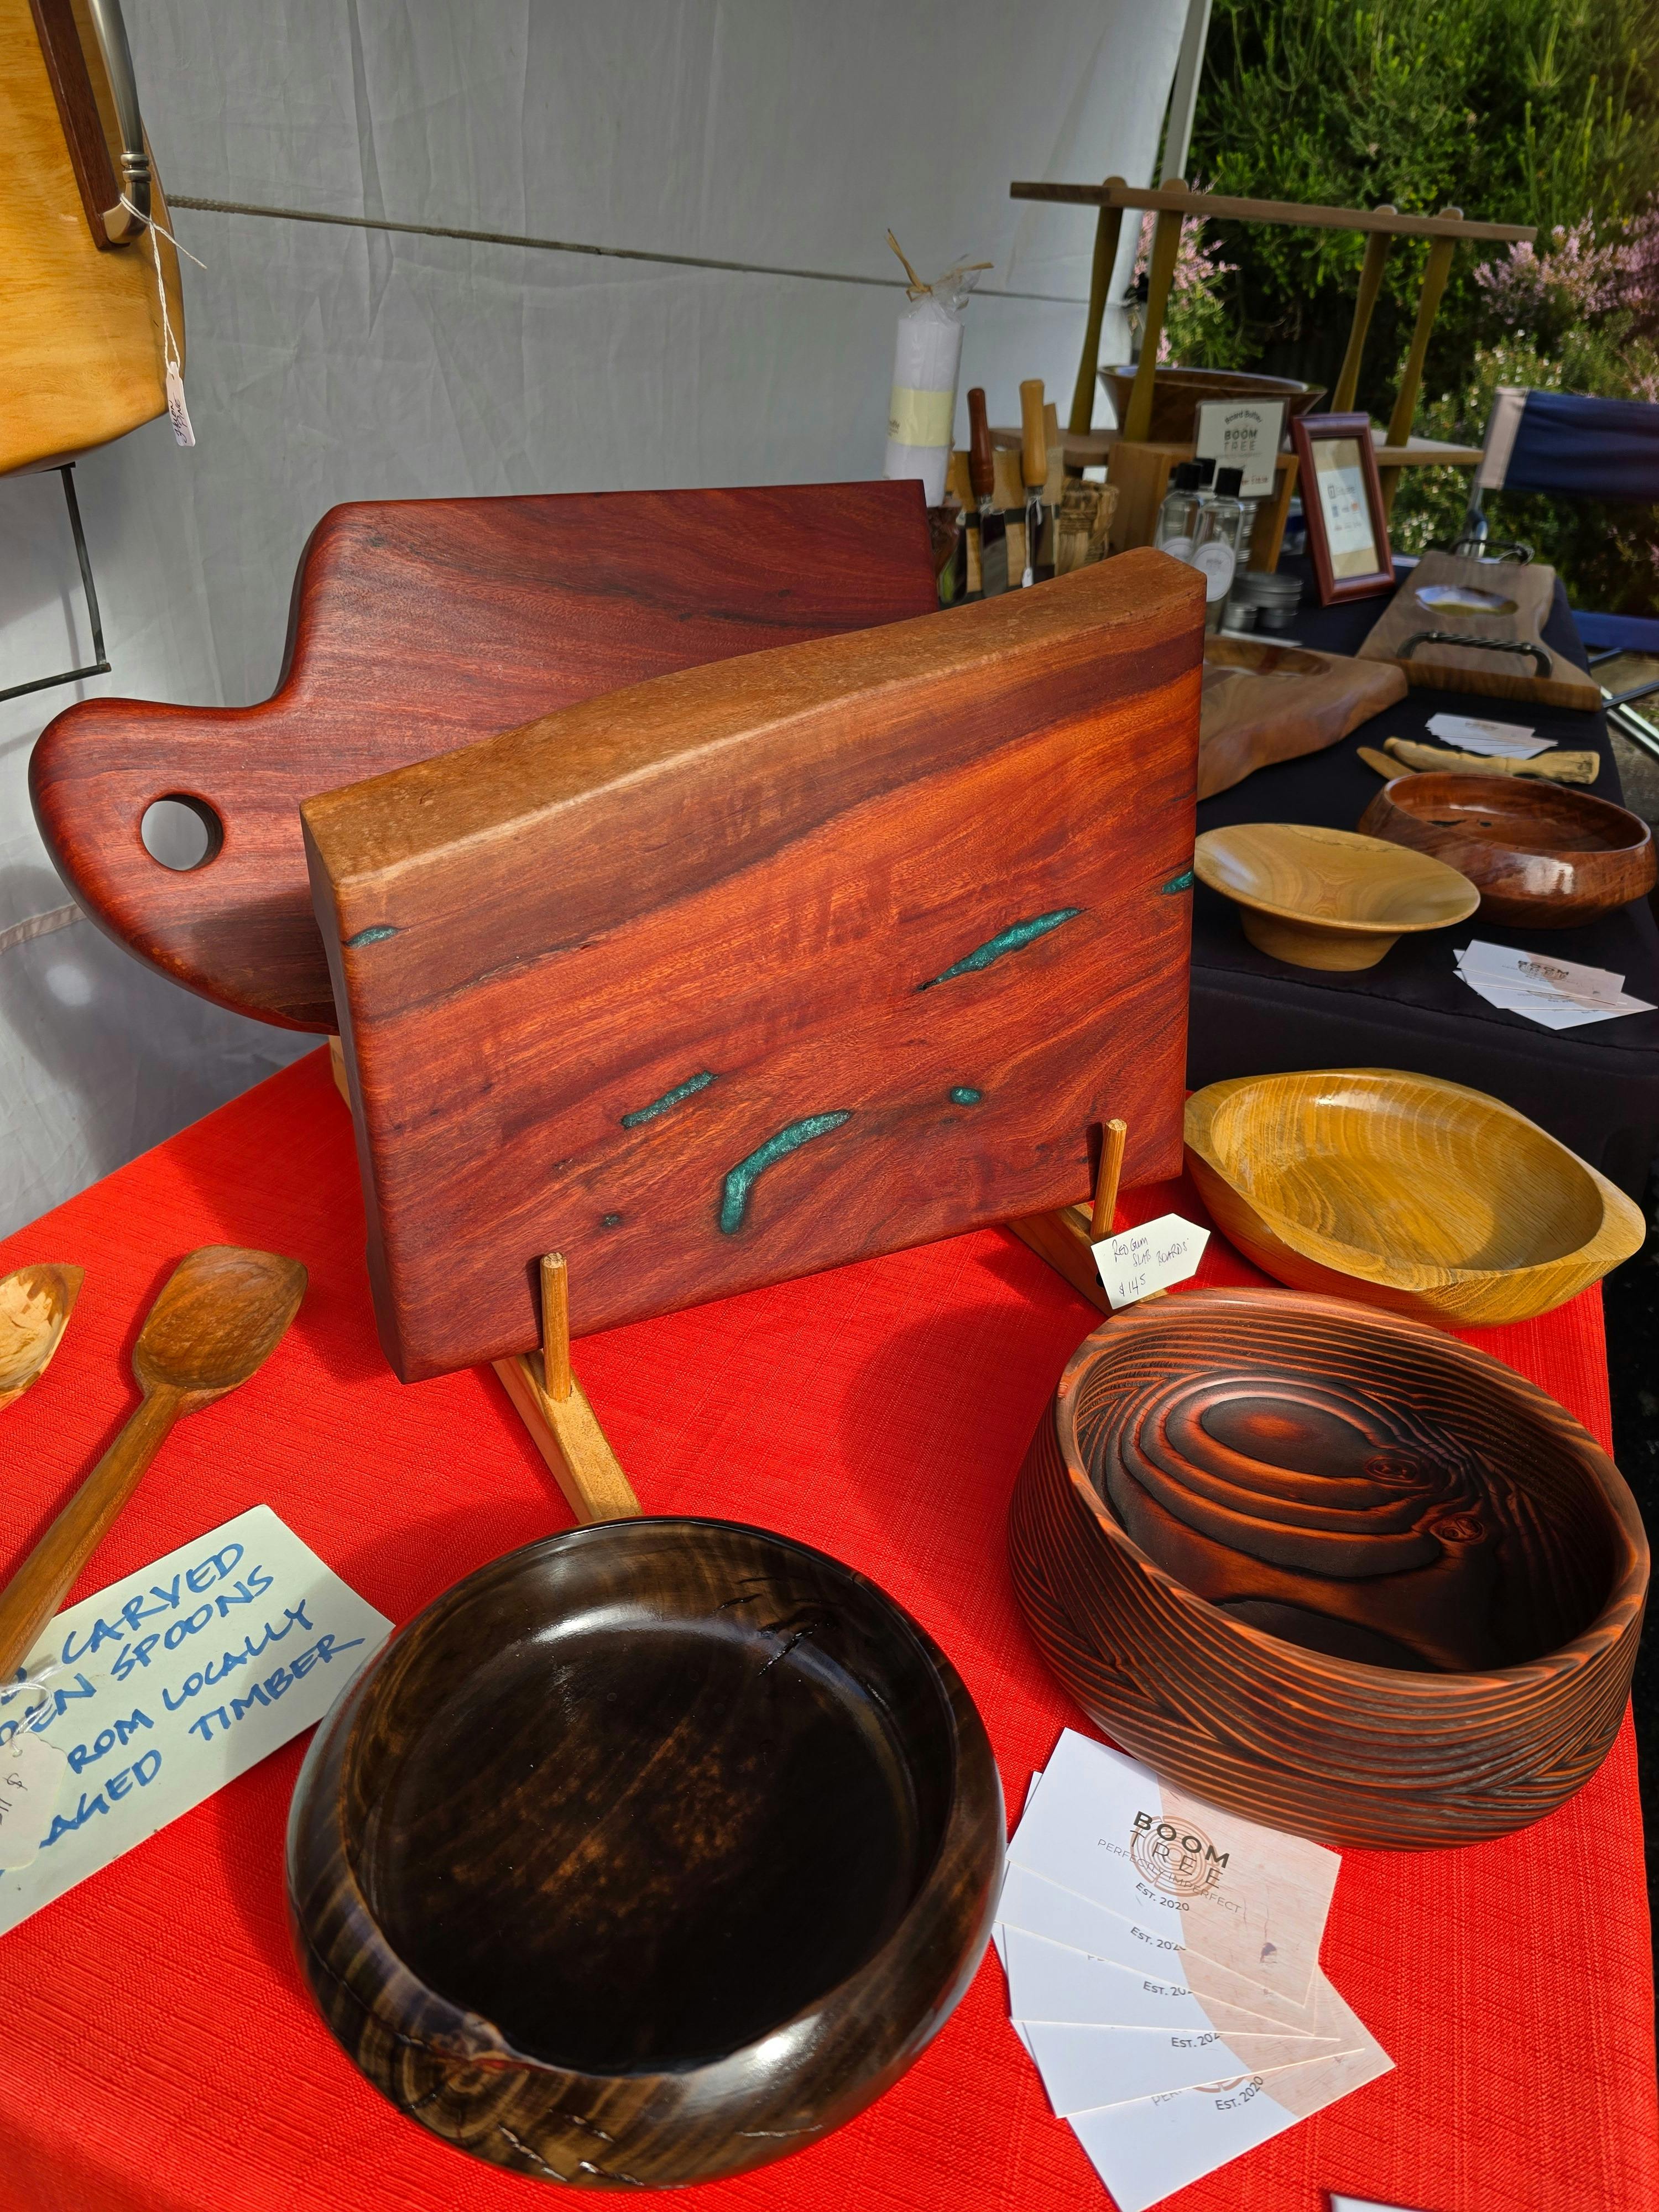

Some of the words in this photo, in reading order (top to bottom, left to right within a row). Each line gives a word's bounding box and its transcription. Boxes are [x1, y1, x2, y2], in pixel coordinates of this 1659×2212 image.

[1224, 429, 1258, 440] BOOM
[1224, 441, 1256, 452] TREE
[1518, 960, 1569, 975] BOOM
[62, 1543, 244, 1664] CARVED
[111, 1565, 274, 1681] SPOONS
[68, 1709, 154, 1773] ROM
[163, 1599, 314, 1710] LOCALLY
[189, 1634, 366, 1741] TIMBER
[1130, 1829, 1224, 1888] TREE
[1133, 1811, 1230, 1869] BOOM
[1097, 1838, 1164, 1878] PERFECTLY
[1168, 1872, 1243, 1913] IMPERFECT
[1159, 1897, 1190, 1911] 2020
[1156, 1939, 1186, 1950] 202
[1197, 2033, 1221, 2046] 202
[1239, 2076, 1263, 2103] 2020
